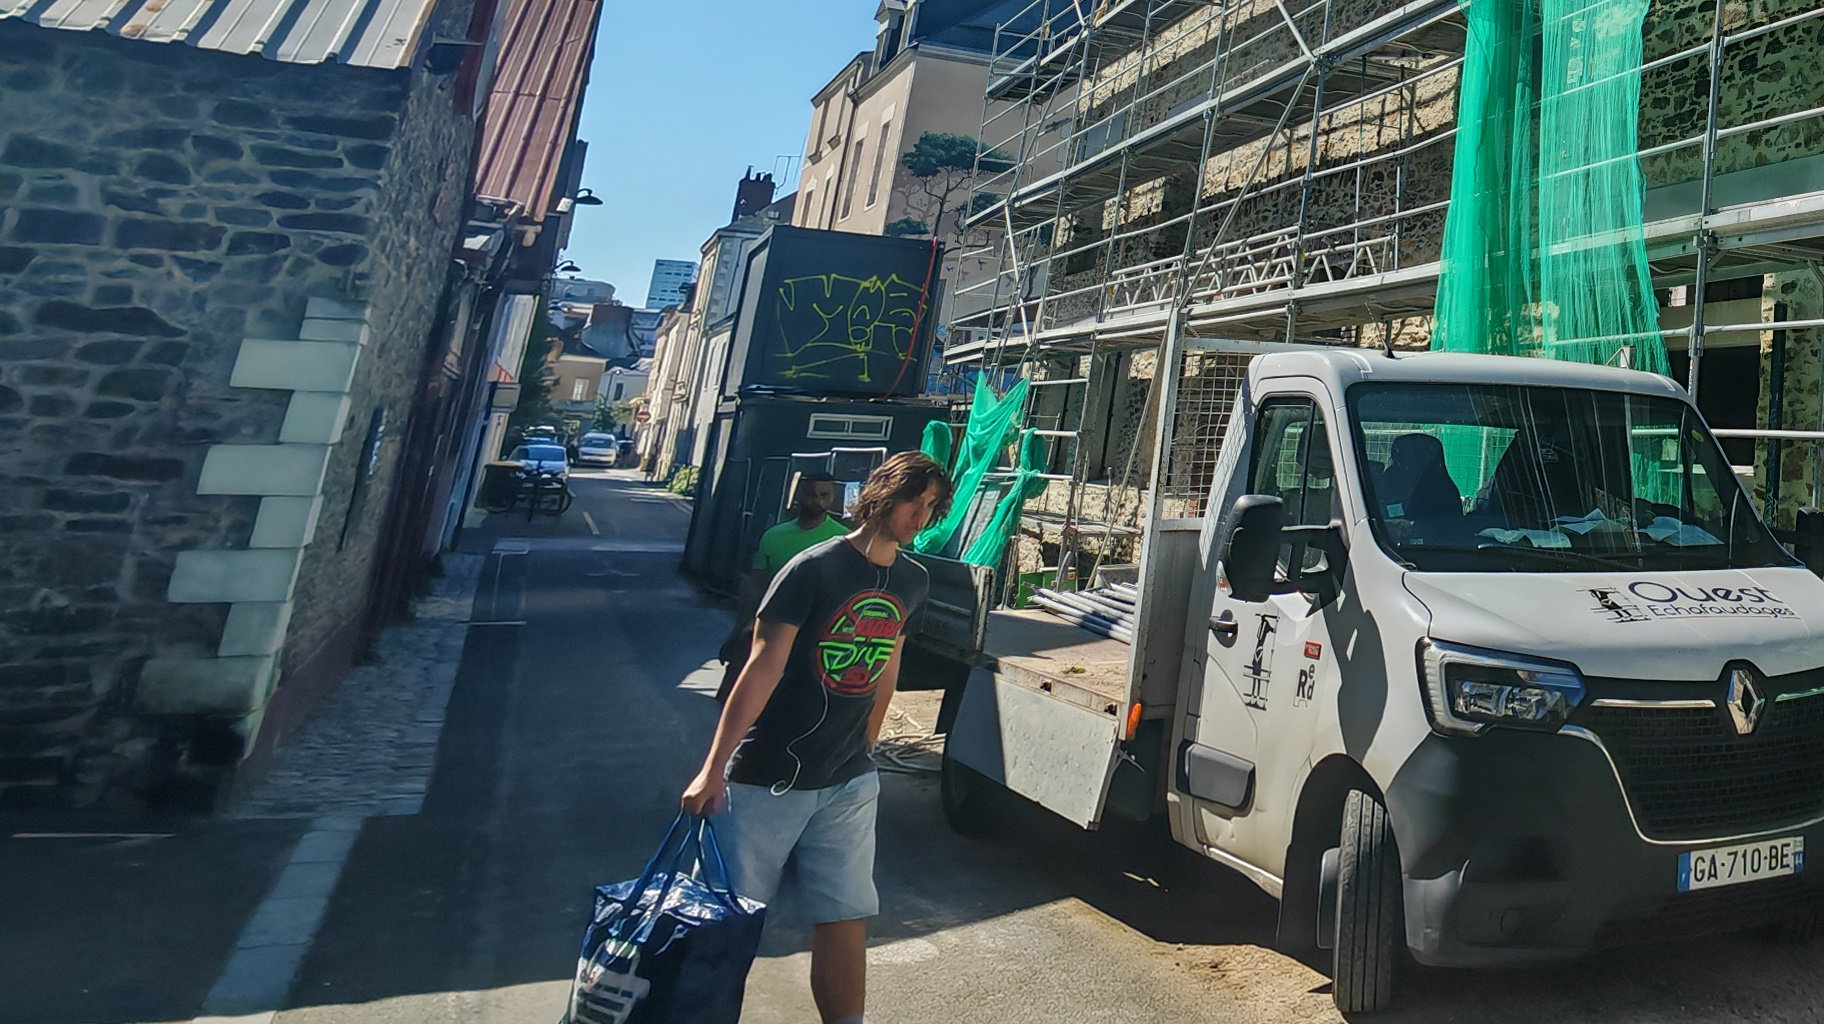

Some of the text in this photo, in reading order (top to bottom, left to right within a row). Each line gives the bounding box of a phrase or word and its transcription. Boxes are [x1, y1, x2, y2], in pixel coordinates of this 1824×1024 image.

[1628, 581, 1784, 604] Ouest
[1646, 603, 1796, 619] Echafaudages
[1693, 842, 1791, 882] GA-710-BE
